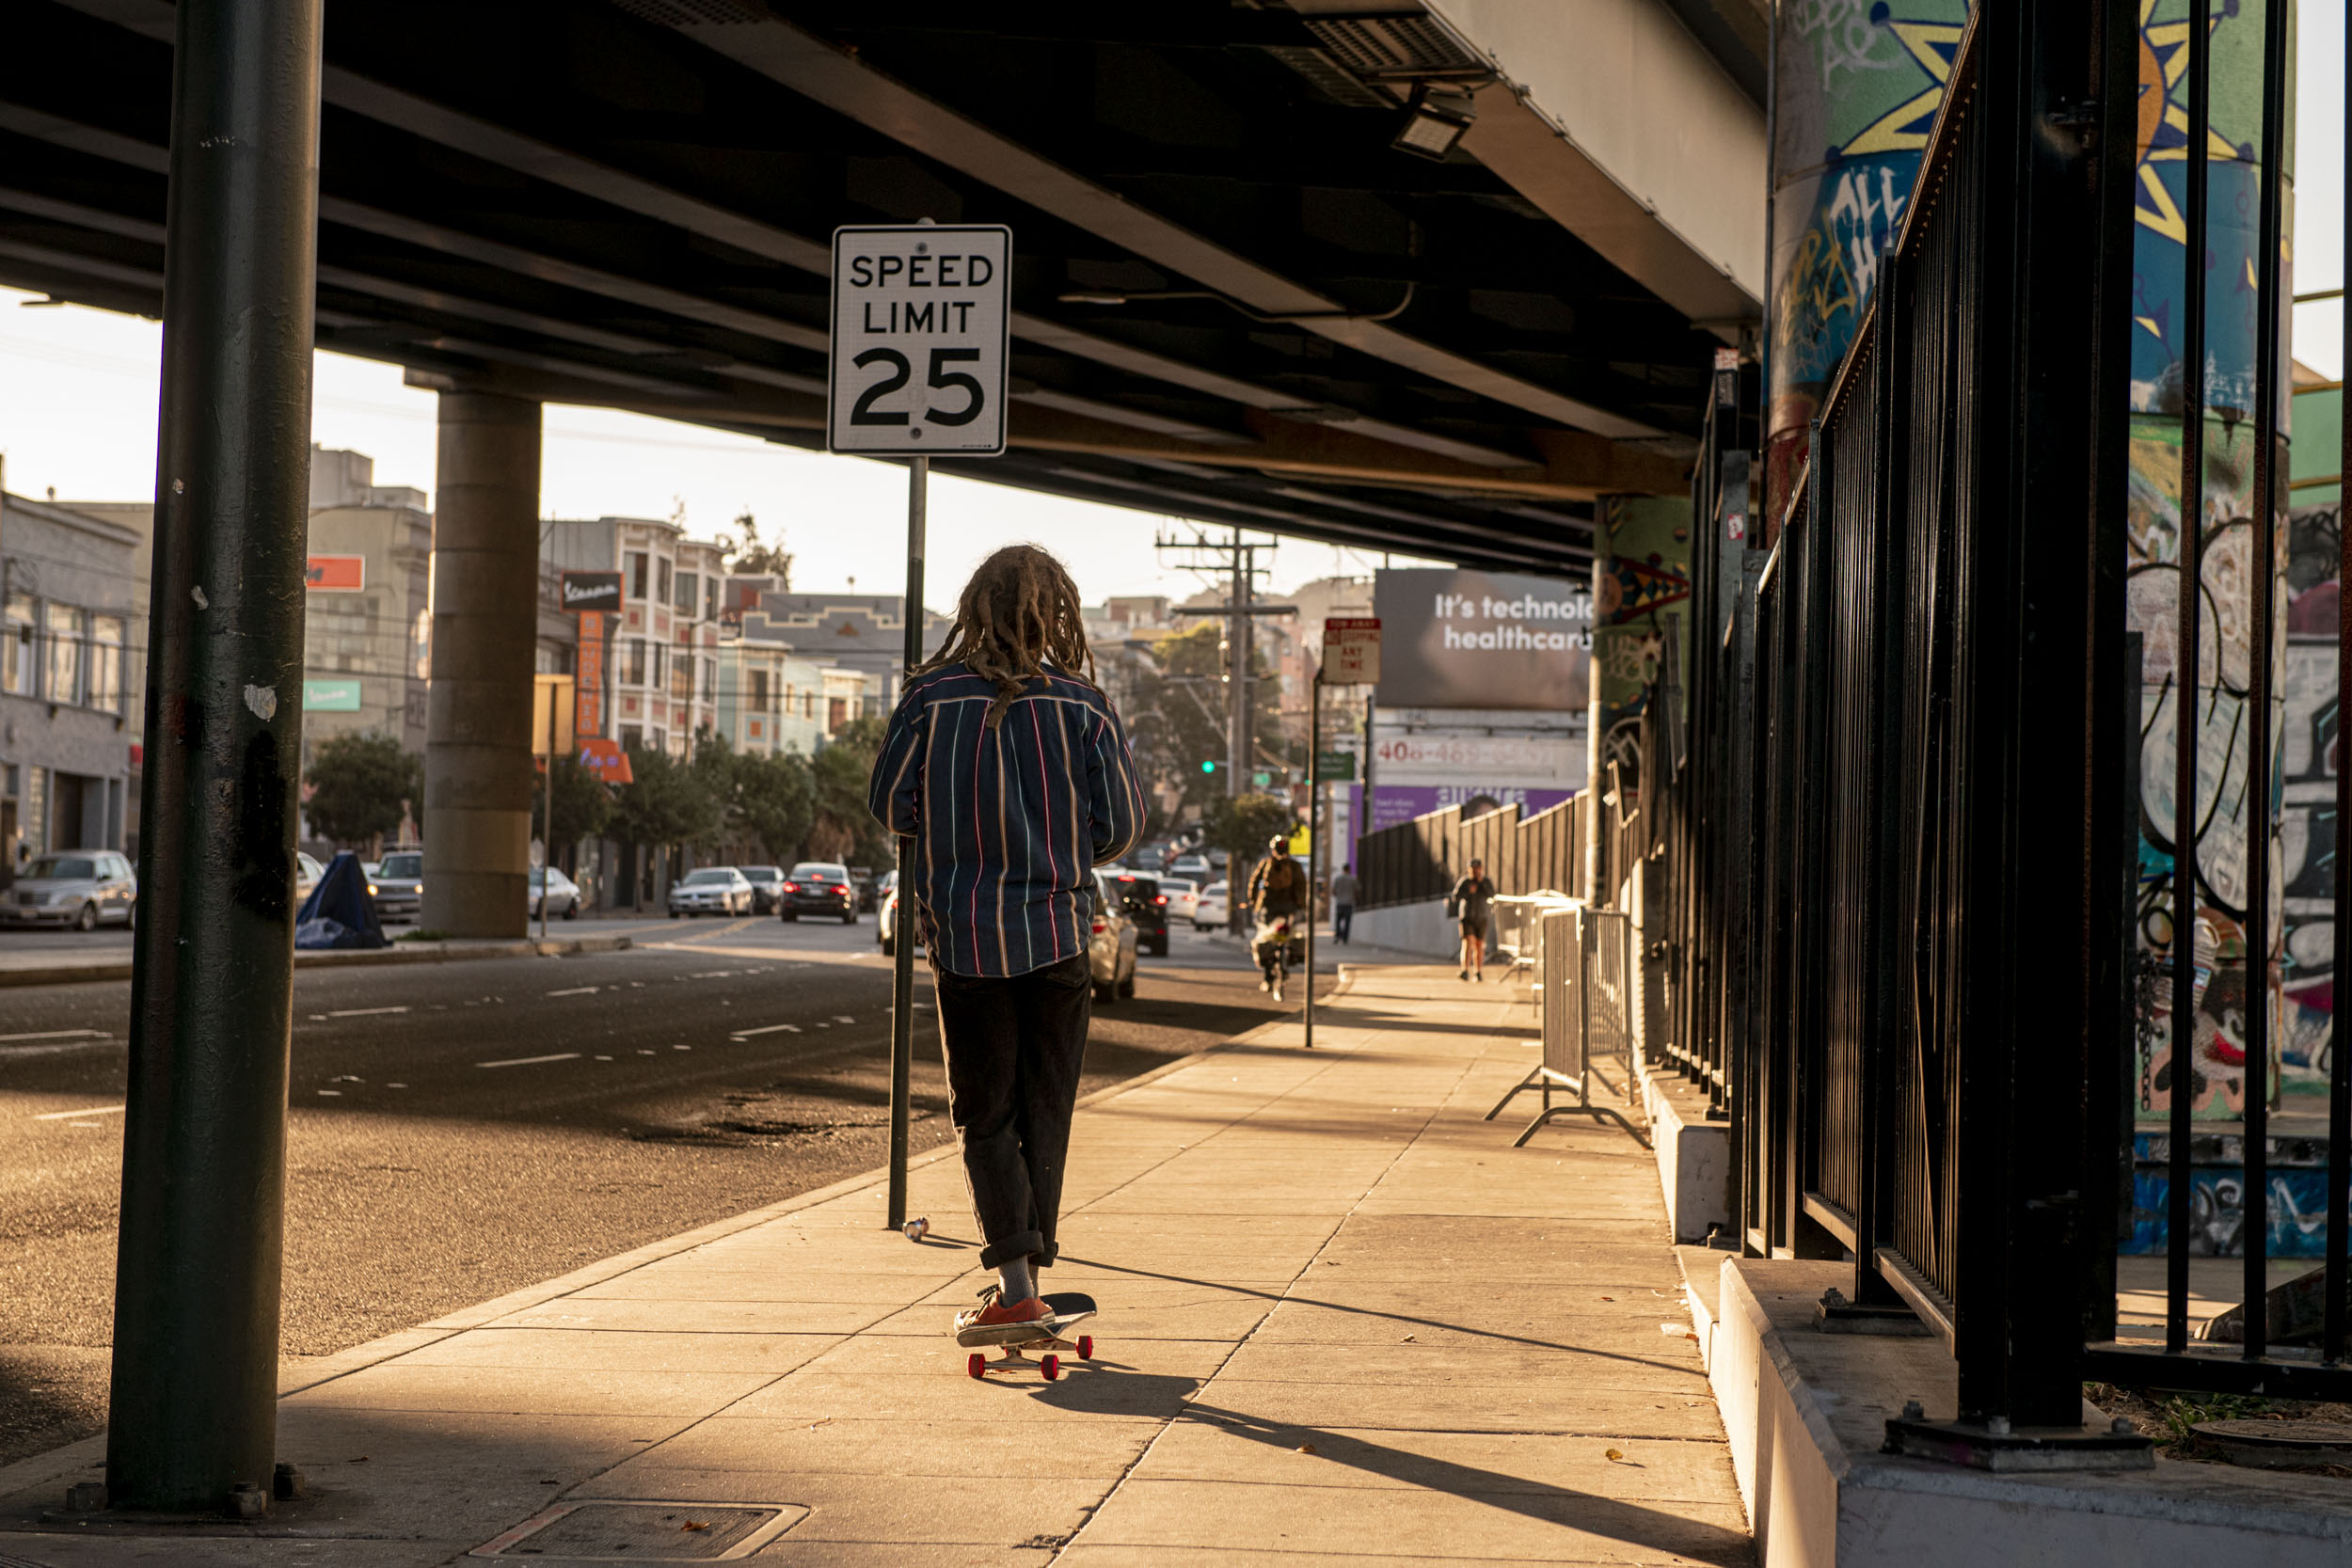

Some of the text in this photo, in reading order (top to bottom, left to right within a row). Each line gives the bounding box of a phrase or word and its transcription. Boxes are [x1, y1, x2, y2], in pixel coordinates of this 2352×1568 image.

[850, 255, 993, 288] SPEED
[864, 301, 976, 334] LIMIT
[850, 346, 985, 427] 25
[1435, 594, 1475, 620] It's
[1341, 659, 1364, 672] TIME
[1342, 646, 1363, 657] ANY
